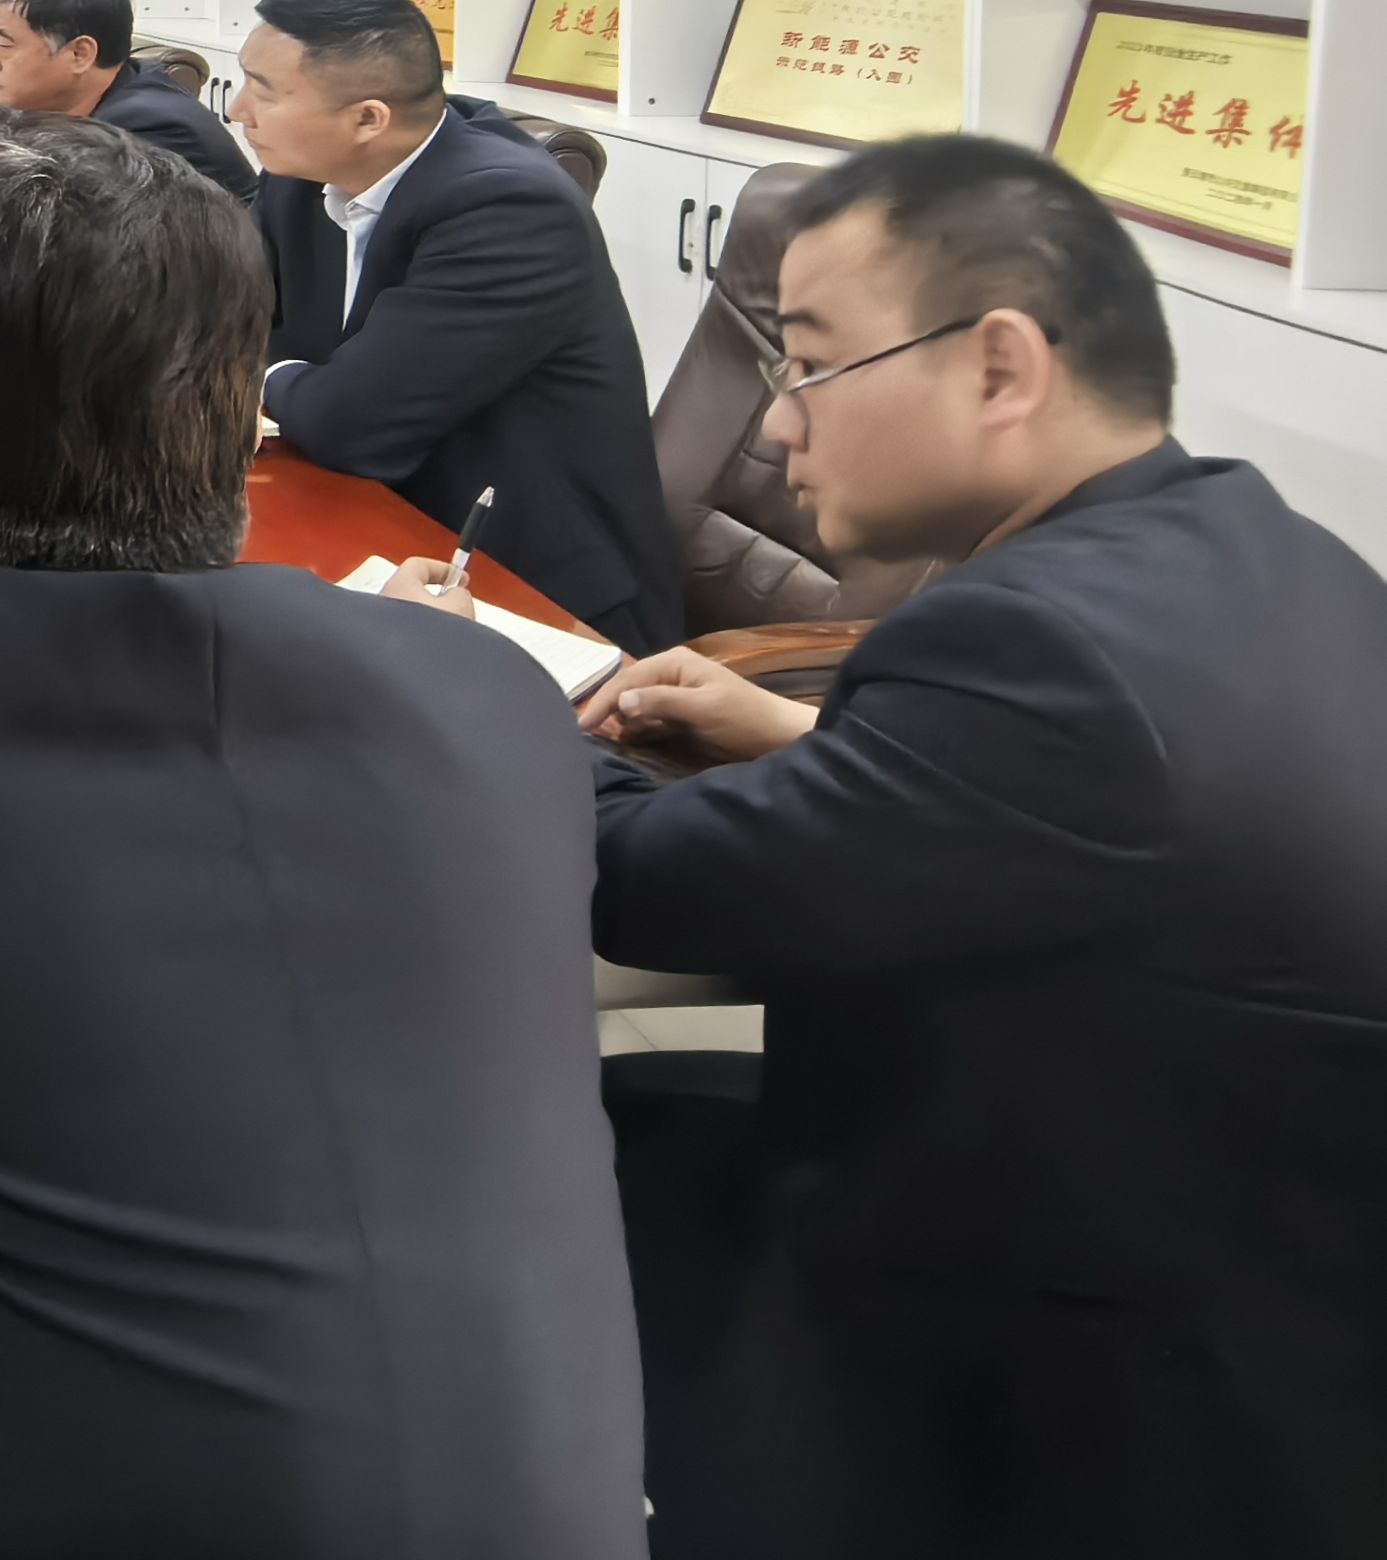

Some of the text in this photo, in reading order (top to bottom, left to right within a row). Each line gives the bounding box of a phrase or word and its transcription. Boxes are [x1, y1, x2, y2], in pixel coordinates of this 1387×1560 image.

[781, 30, 921, 65] 新能源公交
[1106, 79, 1304, 160] 先进集体
